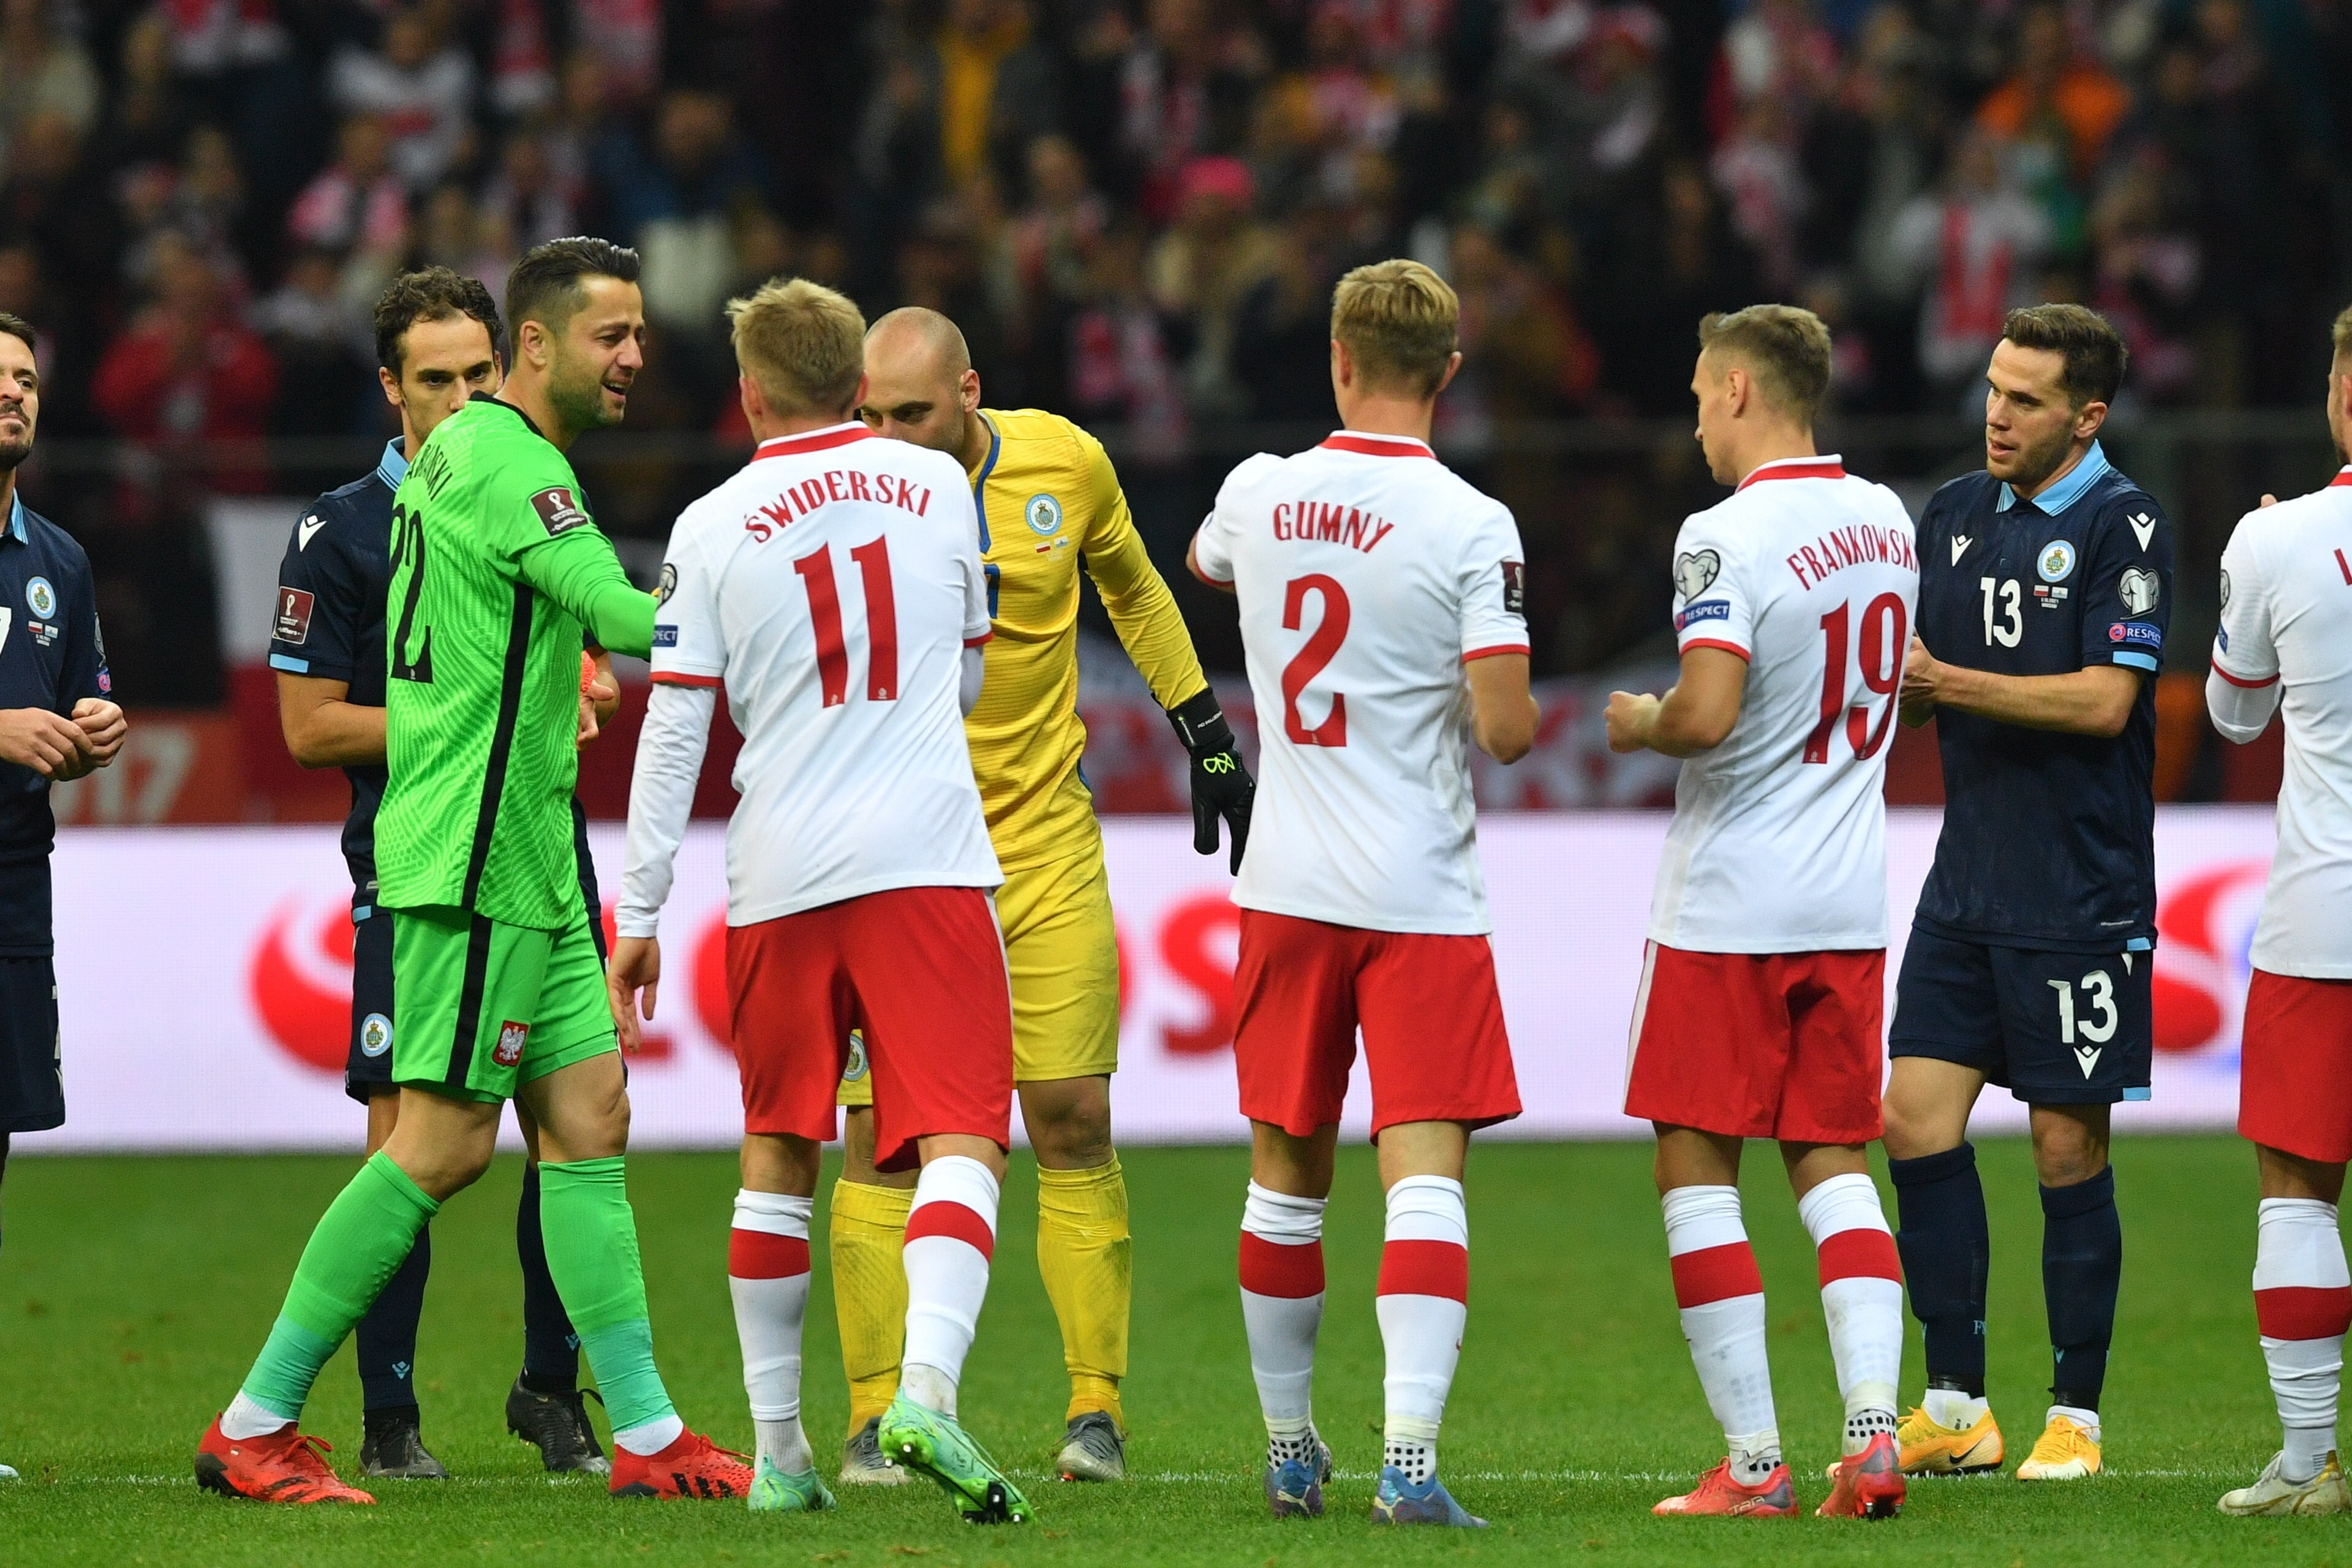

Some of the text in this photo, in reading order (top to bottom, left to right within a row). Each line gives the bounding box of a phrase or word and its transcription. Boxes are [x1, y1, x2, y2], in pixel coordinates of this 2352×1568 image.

[743, 470, 931, 543] ŚWIDERSKI
[1272, 500, 1395, 553] GUMNY
[794, 533, 898, 709] 11
[1686, 605, 1728, 620] RESPECT
[1980, 576, 2022, 648] 13
[1281, 573, 1351, 747] 2
[1801, 591, 1907, 764] 19
[2046, 969, 2119, 1044] 13
